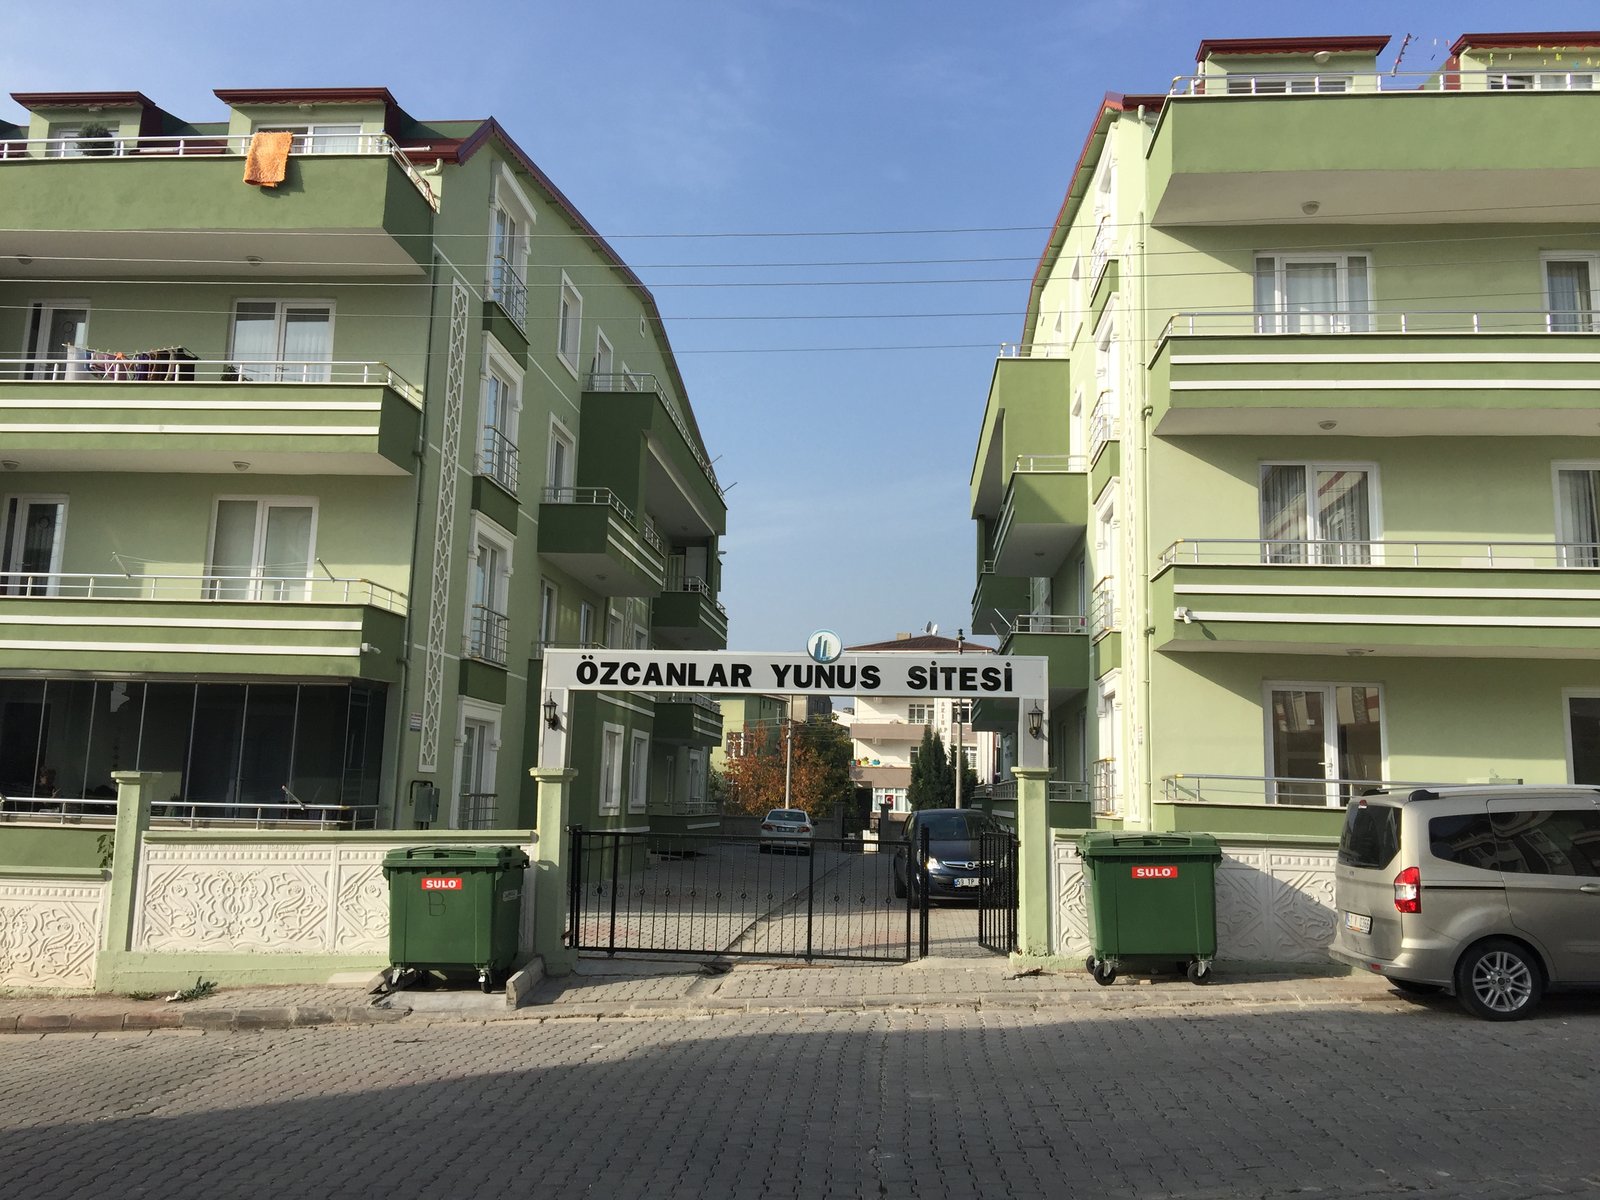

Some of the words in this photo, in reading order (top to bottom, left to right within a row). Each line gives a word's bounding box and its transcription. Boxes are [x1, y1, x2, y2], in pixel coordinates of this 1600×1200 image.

[576, 654, 752, 688] ÖZCANLAR
[770, 663, 881, 690] YUNUS
[906, 660, 1013, 692] SİTESİ
[1137, 868, 1171, 877] SULO
[426, 880, 457, 889] SULO
[427, 891, 448, 917] B
